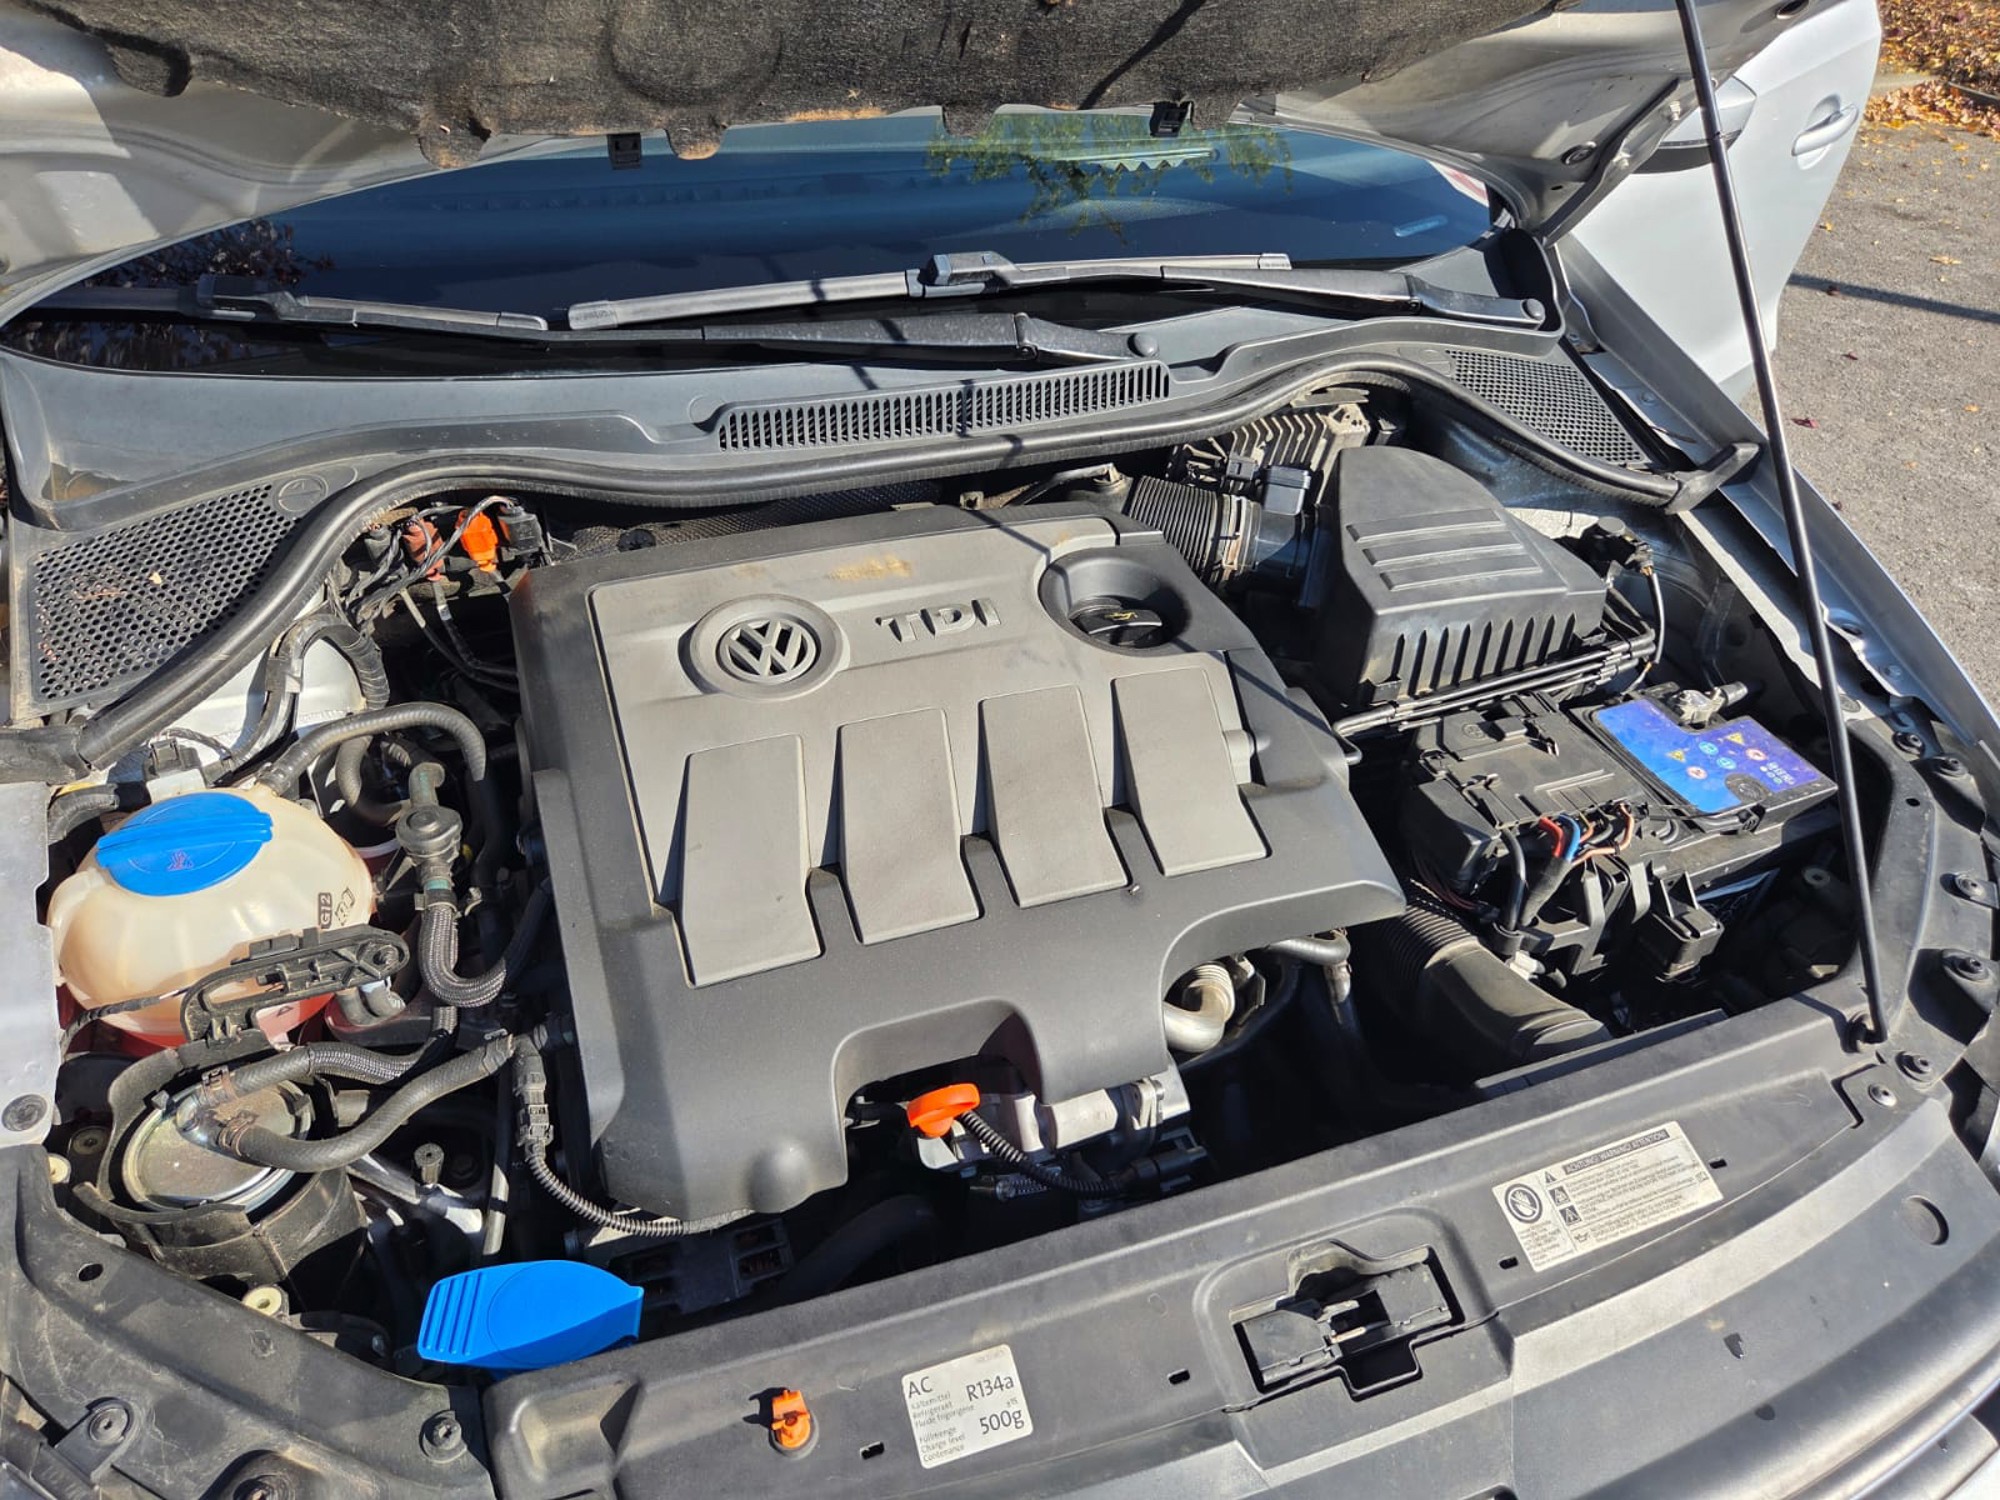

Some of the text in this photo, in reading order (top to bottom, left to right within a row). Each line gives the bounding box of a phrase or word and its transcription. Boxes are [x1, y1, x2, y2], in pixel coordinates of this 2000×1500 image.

[877, 597, 1002, 644] TDI
[320, 895, 331, 925] G12
[908, 1376, 933, 1399] AC
[966, 1375, 1014, 1402] R134a
[979, 1408, 1025, 1435] 500g
